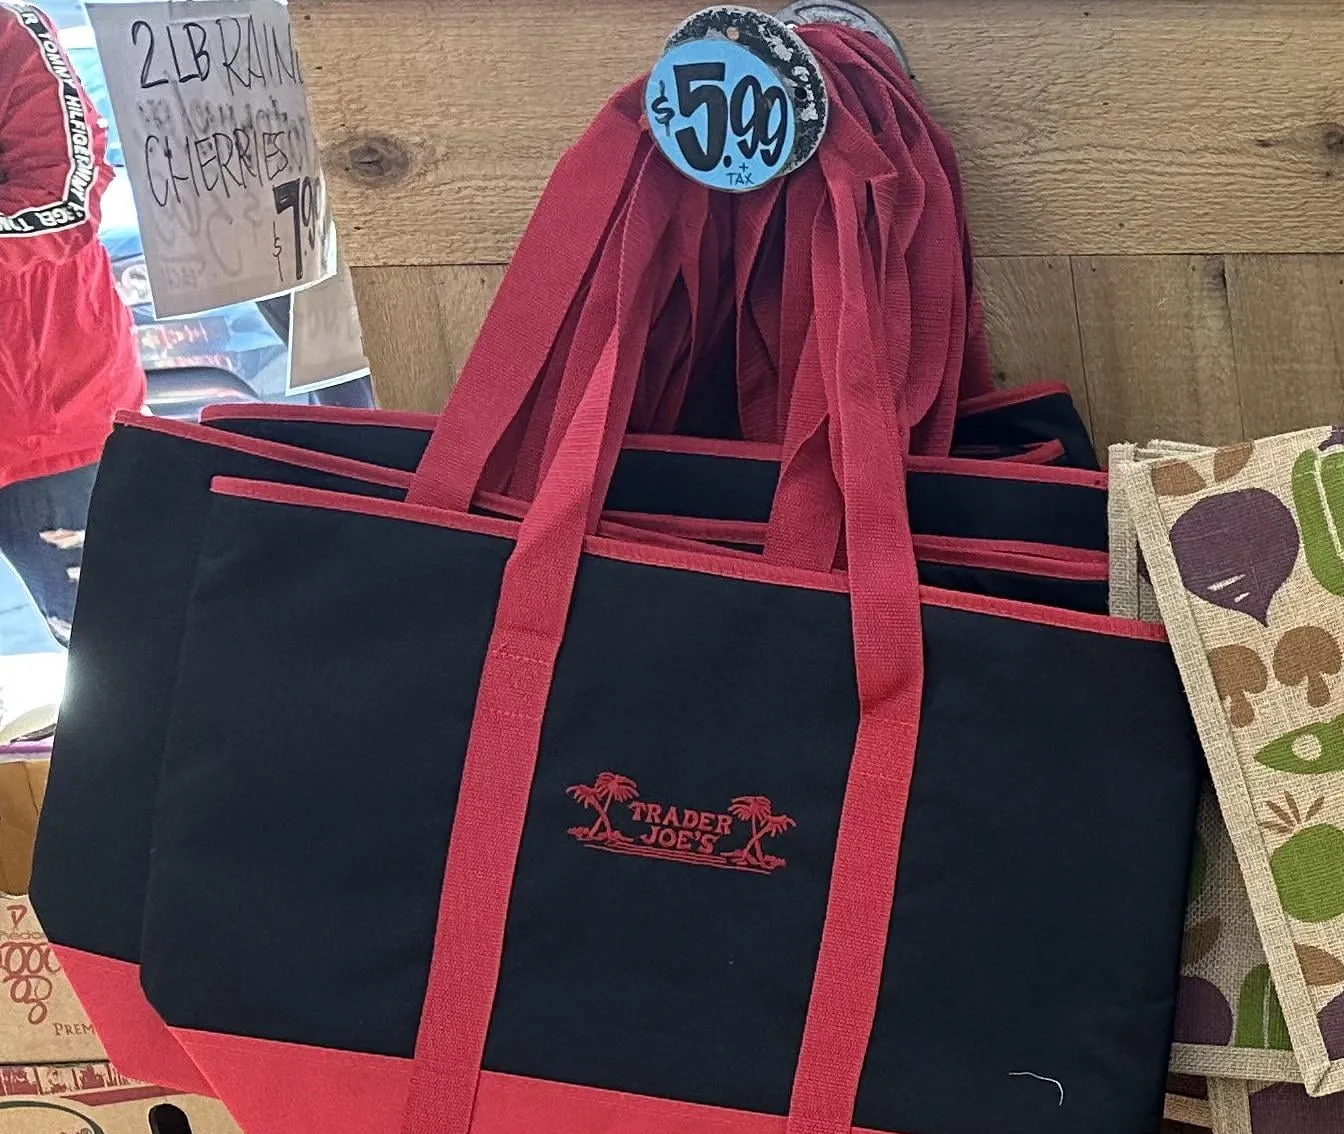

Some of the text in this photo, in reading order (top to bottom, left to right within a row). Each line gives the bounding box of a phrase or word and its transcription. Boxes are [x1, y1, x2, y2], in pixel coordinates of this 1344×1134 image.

[131, 20, 169, 89] 2
[166, 21, 212, 83] LB
[651, 62, 788, 172] $5.99
[145, 129, 289, 207] CHERRIES
[726, 172, 755, 185] TAX
[629, 800, 733, 835] TRADER
[640, 826, 722, 854] JOE'S
[55, 1022, 96, 1036] PREM
